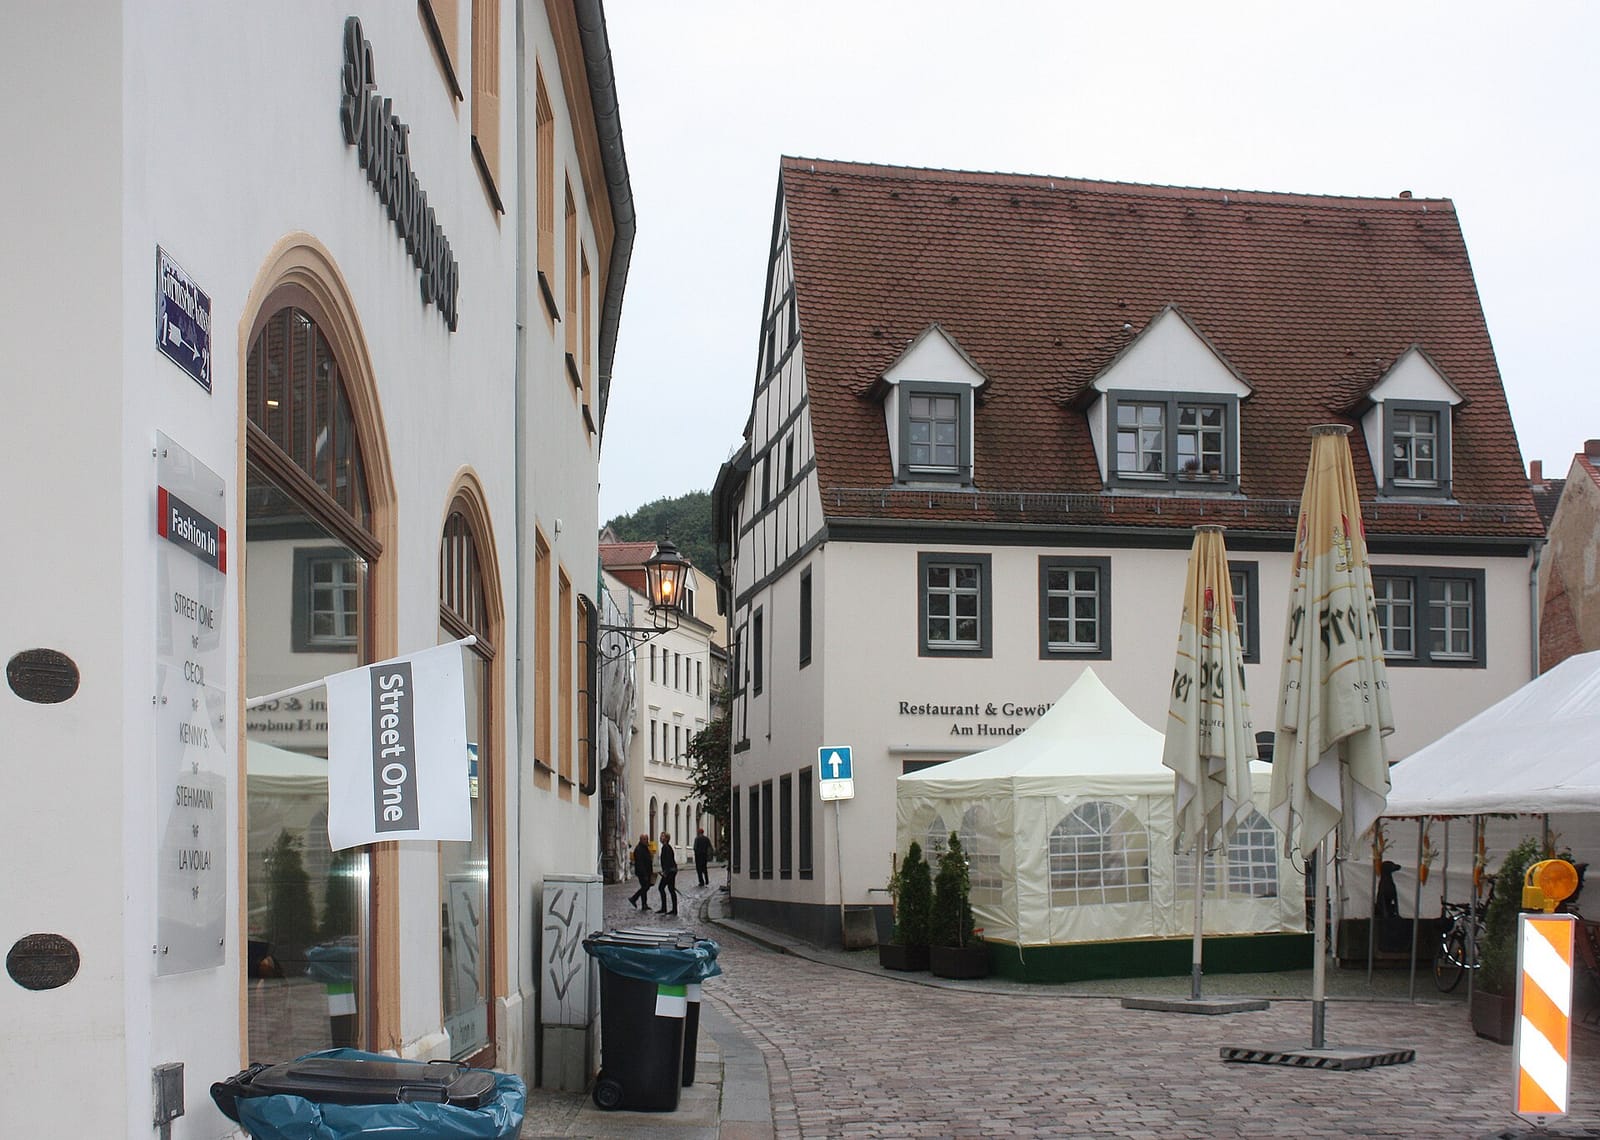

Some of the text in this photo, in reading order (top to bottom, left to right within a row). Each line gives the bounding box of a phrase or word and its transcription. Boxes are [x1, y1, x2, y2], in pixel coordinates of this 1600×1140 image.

[161, 312, 210, 384] 1 21
[172, 508, 207, 550] Fashion
[174, 592, 214, 629] STREET ONE
[184, 660, 206, 687] CECIL
[899, 701, 1055, 716] Restaurant & Gewöl
[179, 721, 203, 747] KENNY
[950, 723, 1029, 737] Am Hunde
[379, 673, 408, 822] Street One
[176, 785, 214, 810] STEHMANN
[178, 849, 188, 870] LA
